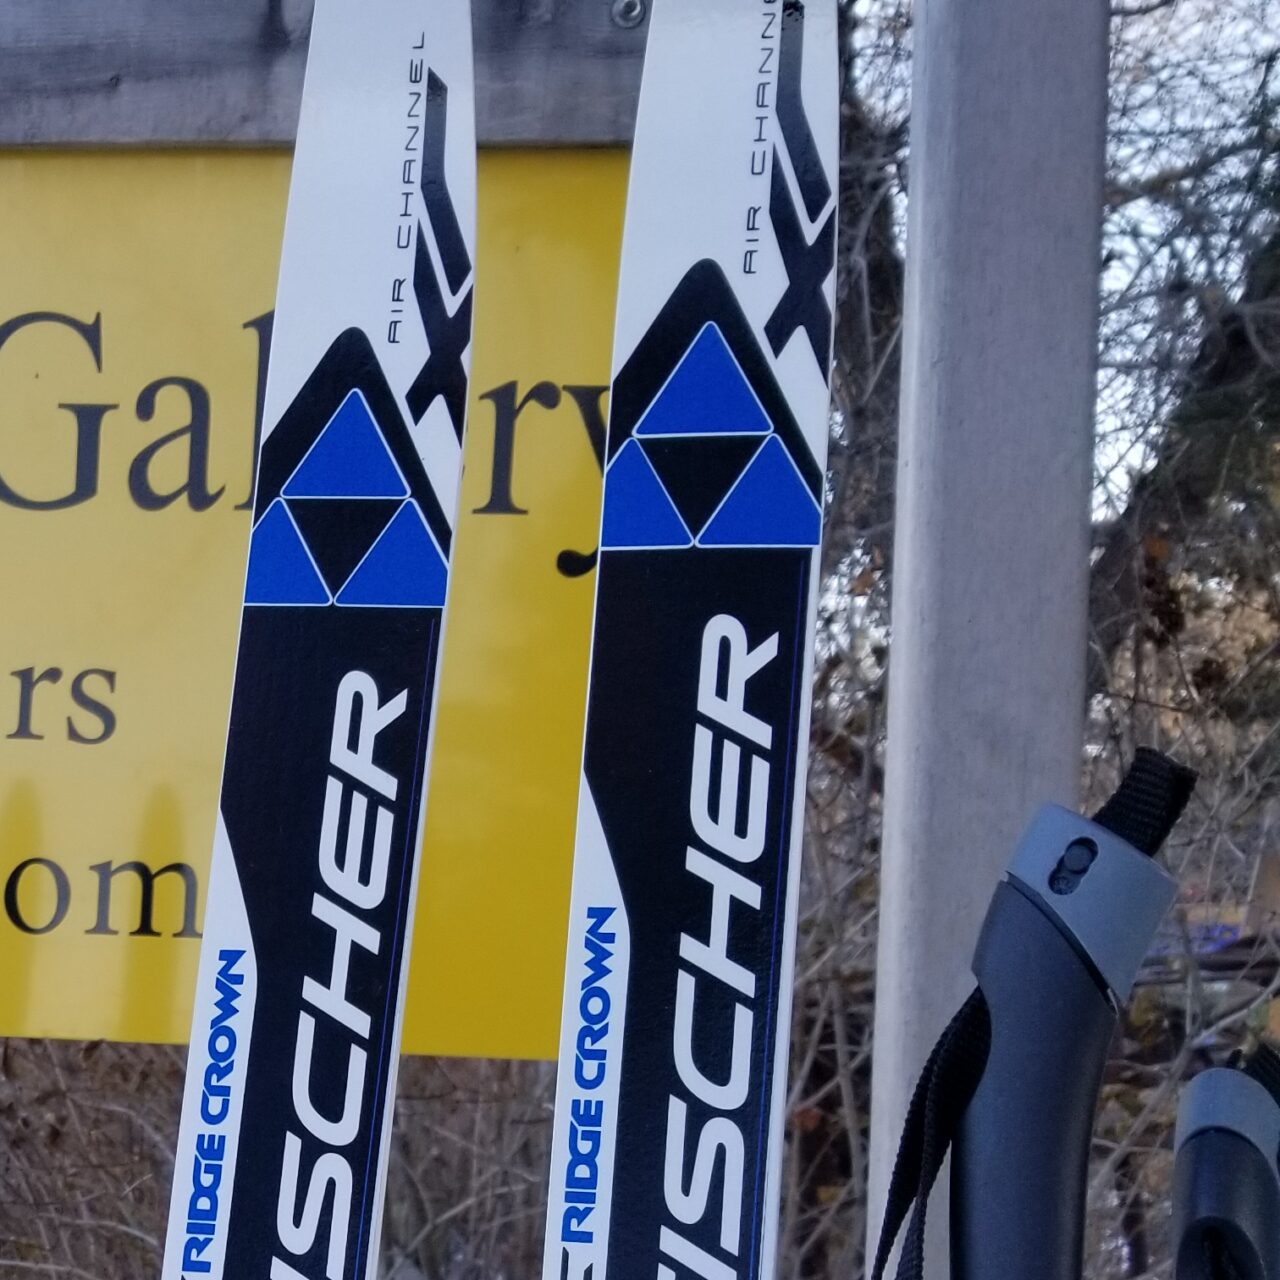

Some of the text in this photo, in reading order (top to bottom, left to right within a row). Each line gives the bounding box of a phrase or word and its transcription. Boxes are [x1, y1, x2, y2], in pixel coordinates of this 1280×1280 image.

[387, 31, 425, 344] AIR CHANNEL
[742, 0, 778, 275] AIR CHANN
[182, 1133, 226, 1273] RIDGE
[205, 949, 247, 1126] CROWN
[575, 906, 617, 1090] CROWN
[561, 1098, 603, 1243] RIDGE
